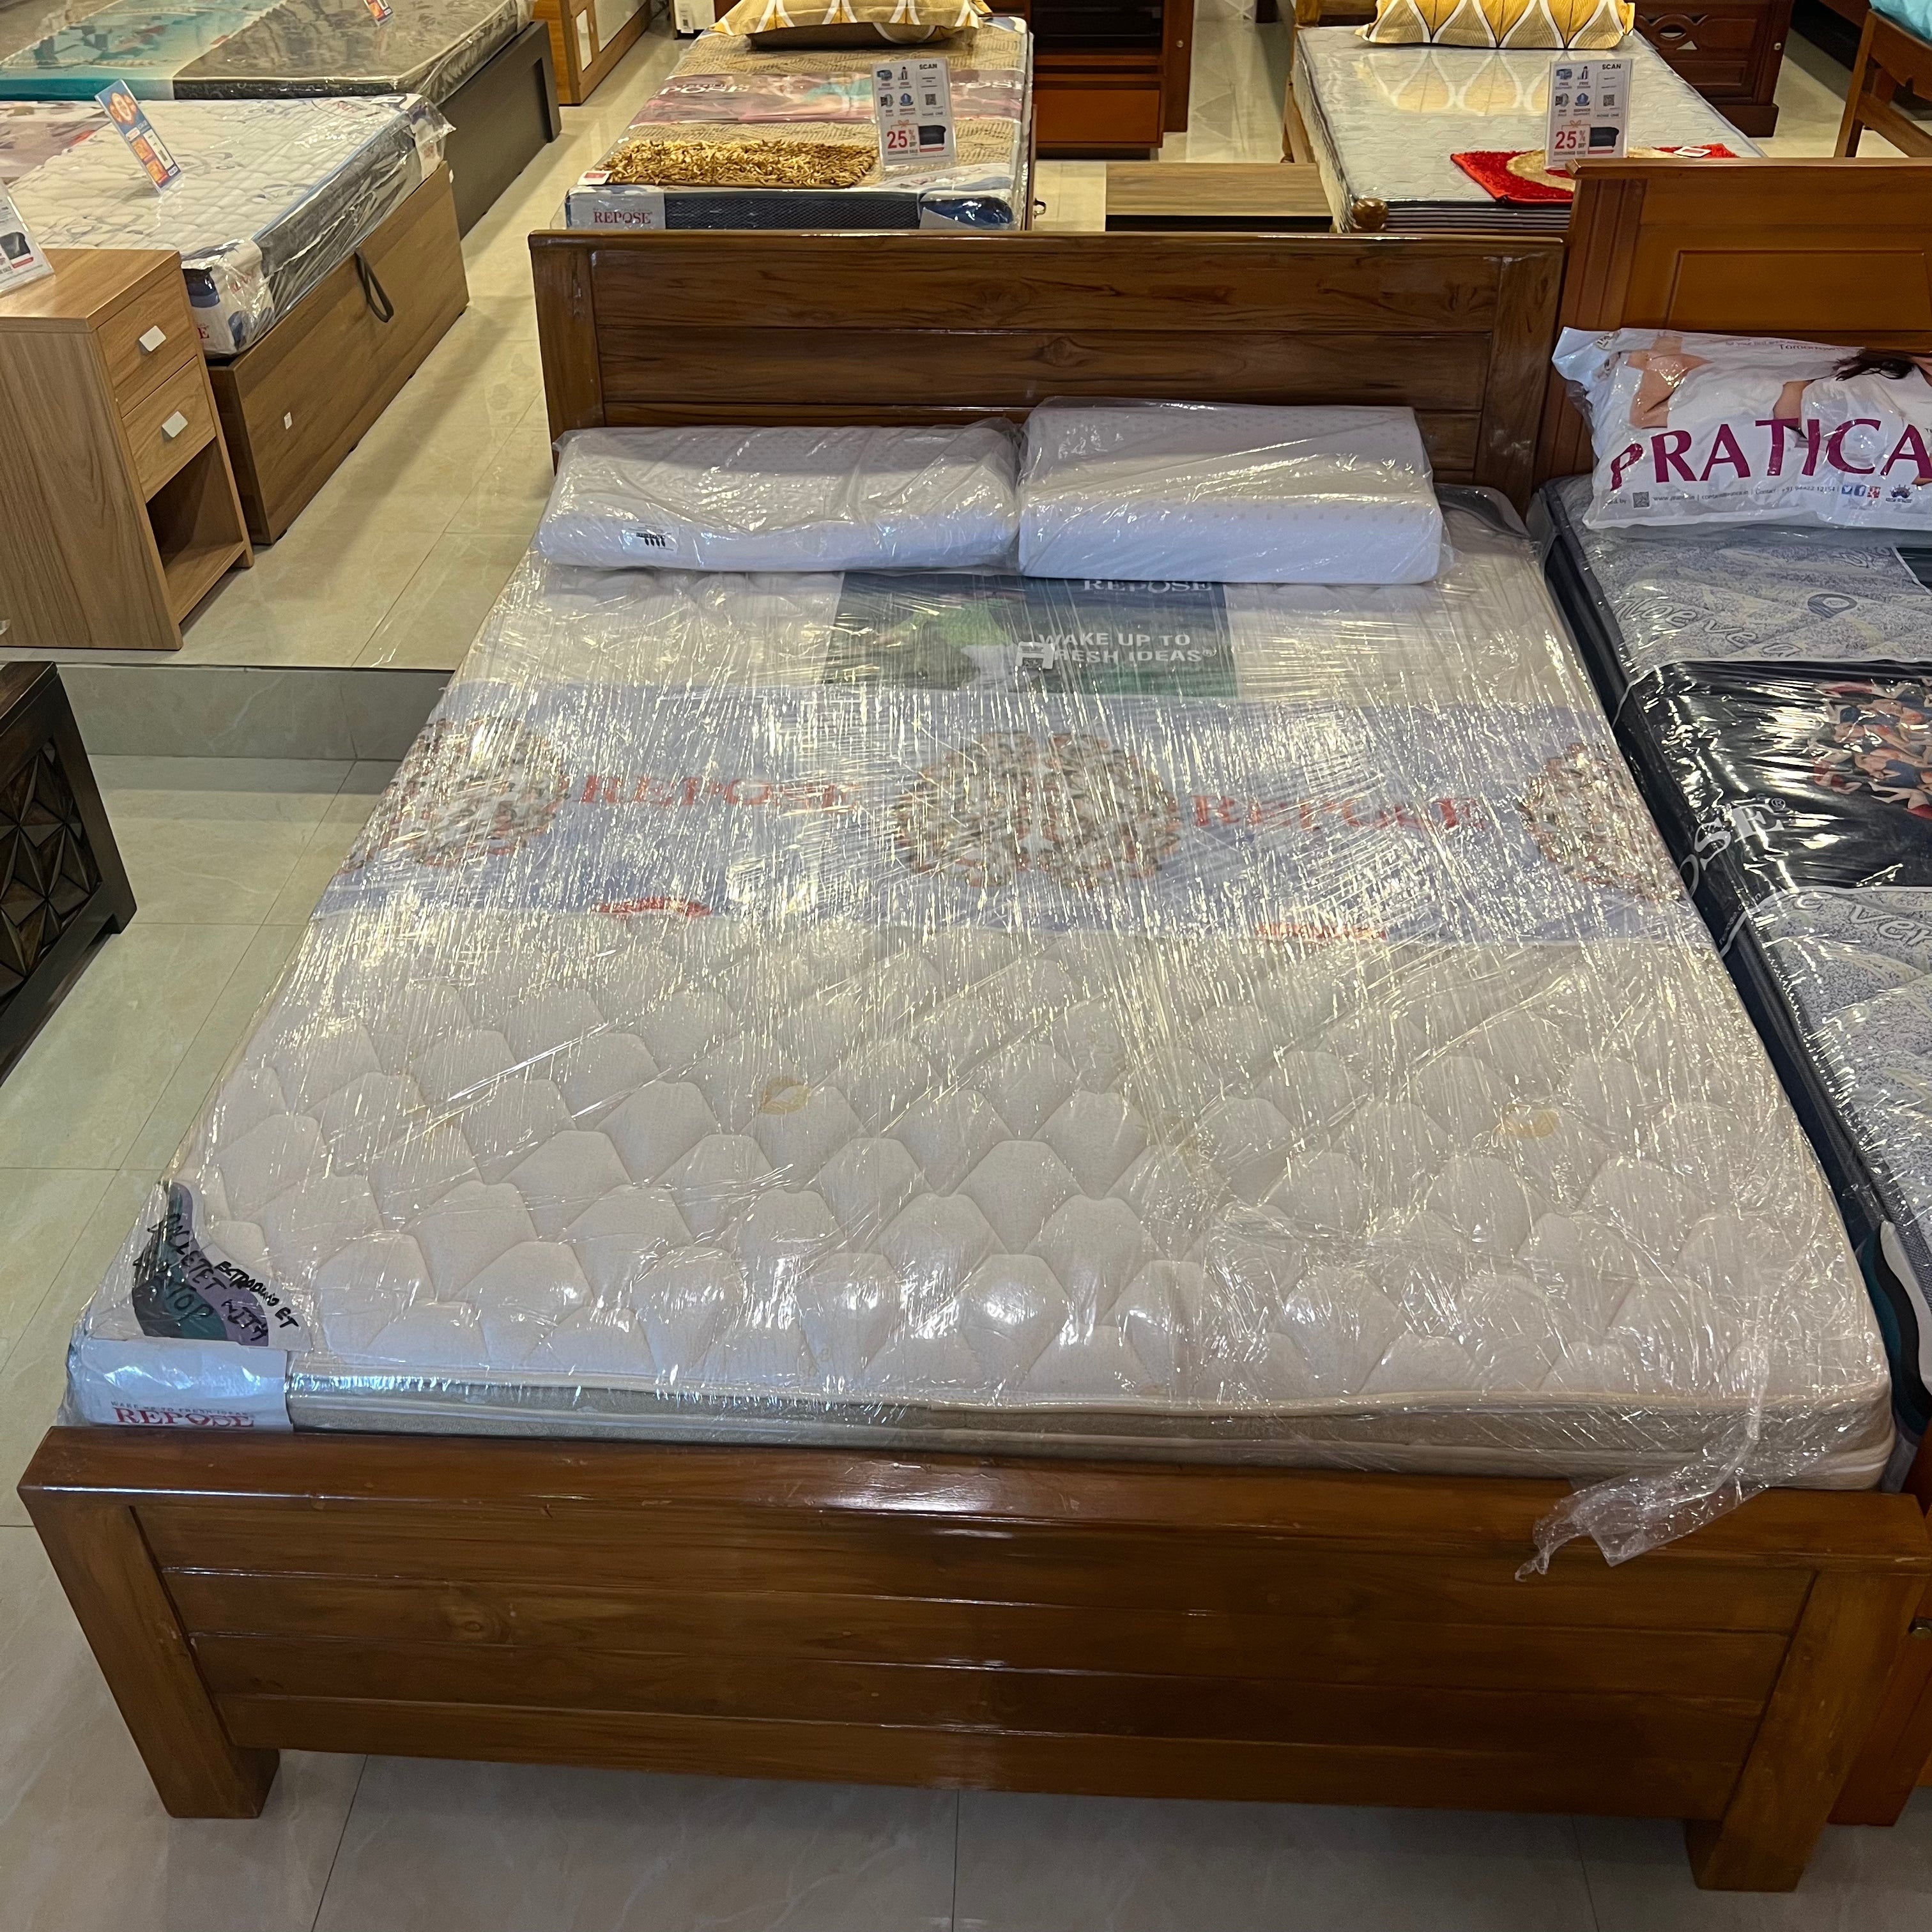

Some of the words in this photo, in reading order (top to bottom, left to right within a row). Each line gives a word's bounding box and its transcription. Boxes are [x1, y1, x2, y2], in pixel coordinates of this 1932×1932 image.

[887, 130, 907, 149] 25
[1554, 131, 1577, 150] 25
[594, 211, 652, 224] REPOSE
[1610, 418, 1932, 491] PRATICA
[1039, 633, 1109, 646] WAKE
[1118, 633, 1150, 646] UP
[1158, 634, 1190, 645] TO
[1053, 648, 1118, 664] RESH
[112, 1407, 255, 1427] REPOSE
